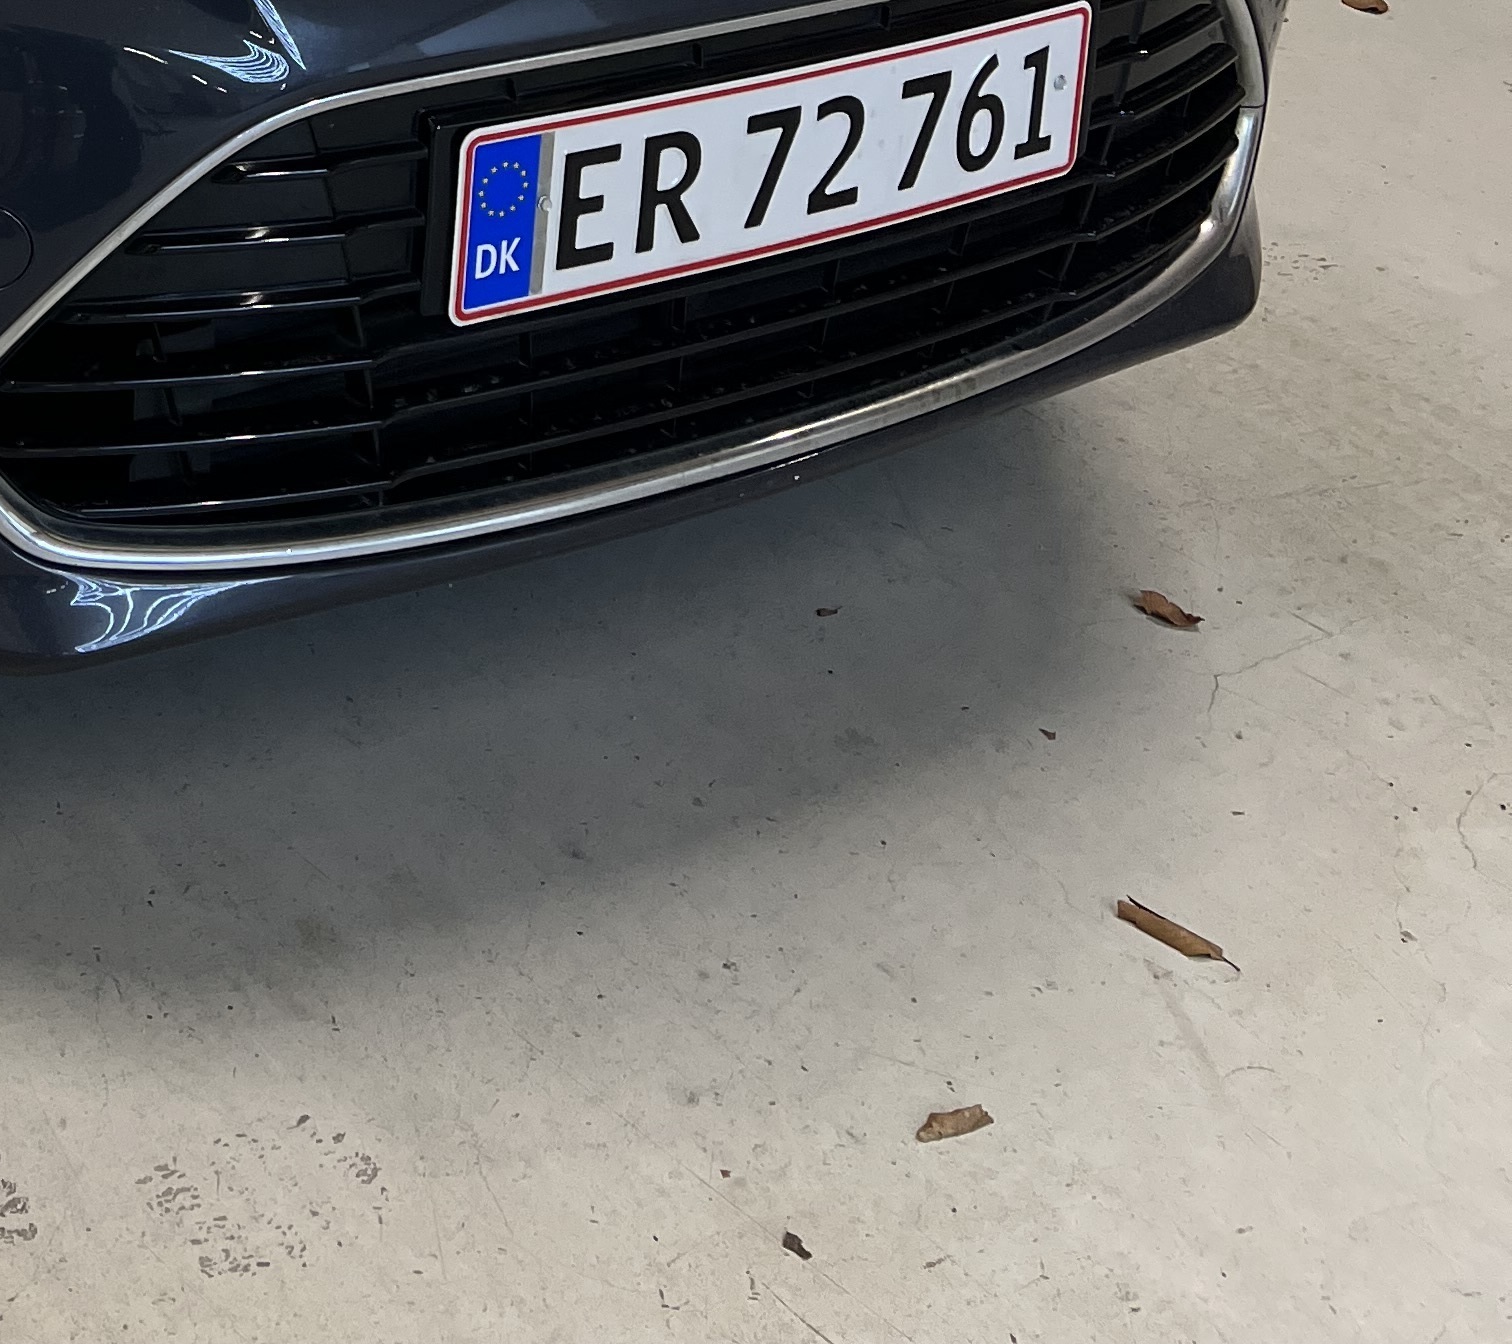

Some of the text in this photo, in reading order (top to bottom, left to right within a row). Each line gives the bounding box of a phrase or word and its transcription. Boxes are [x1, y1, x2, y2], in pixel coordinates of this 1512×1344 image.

[555, 44, 1053, 271] ER 72 761
[473, 236, 521, 280] DK
